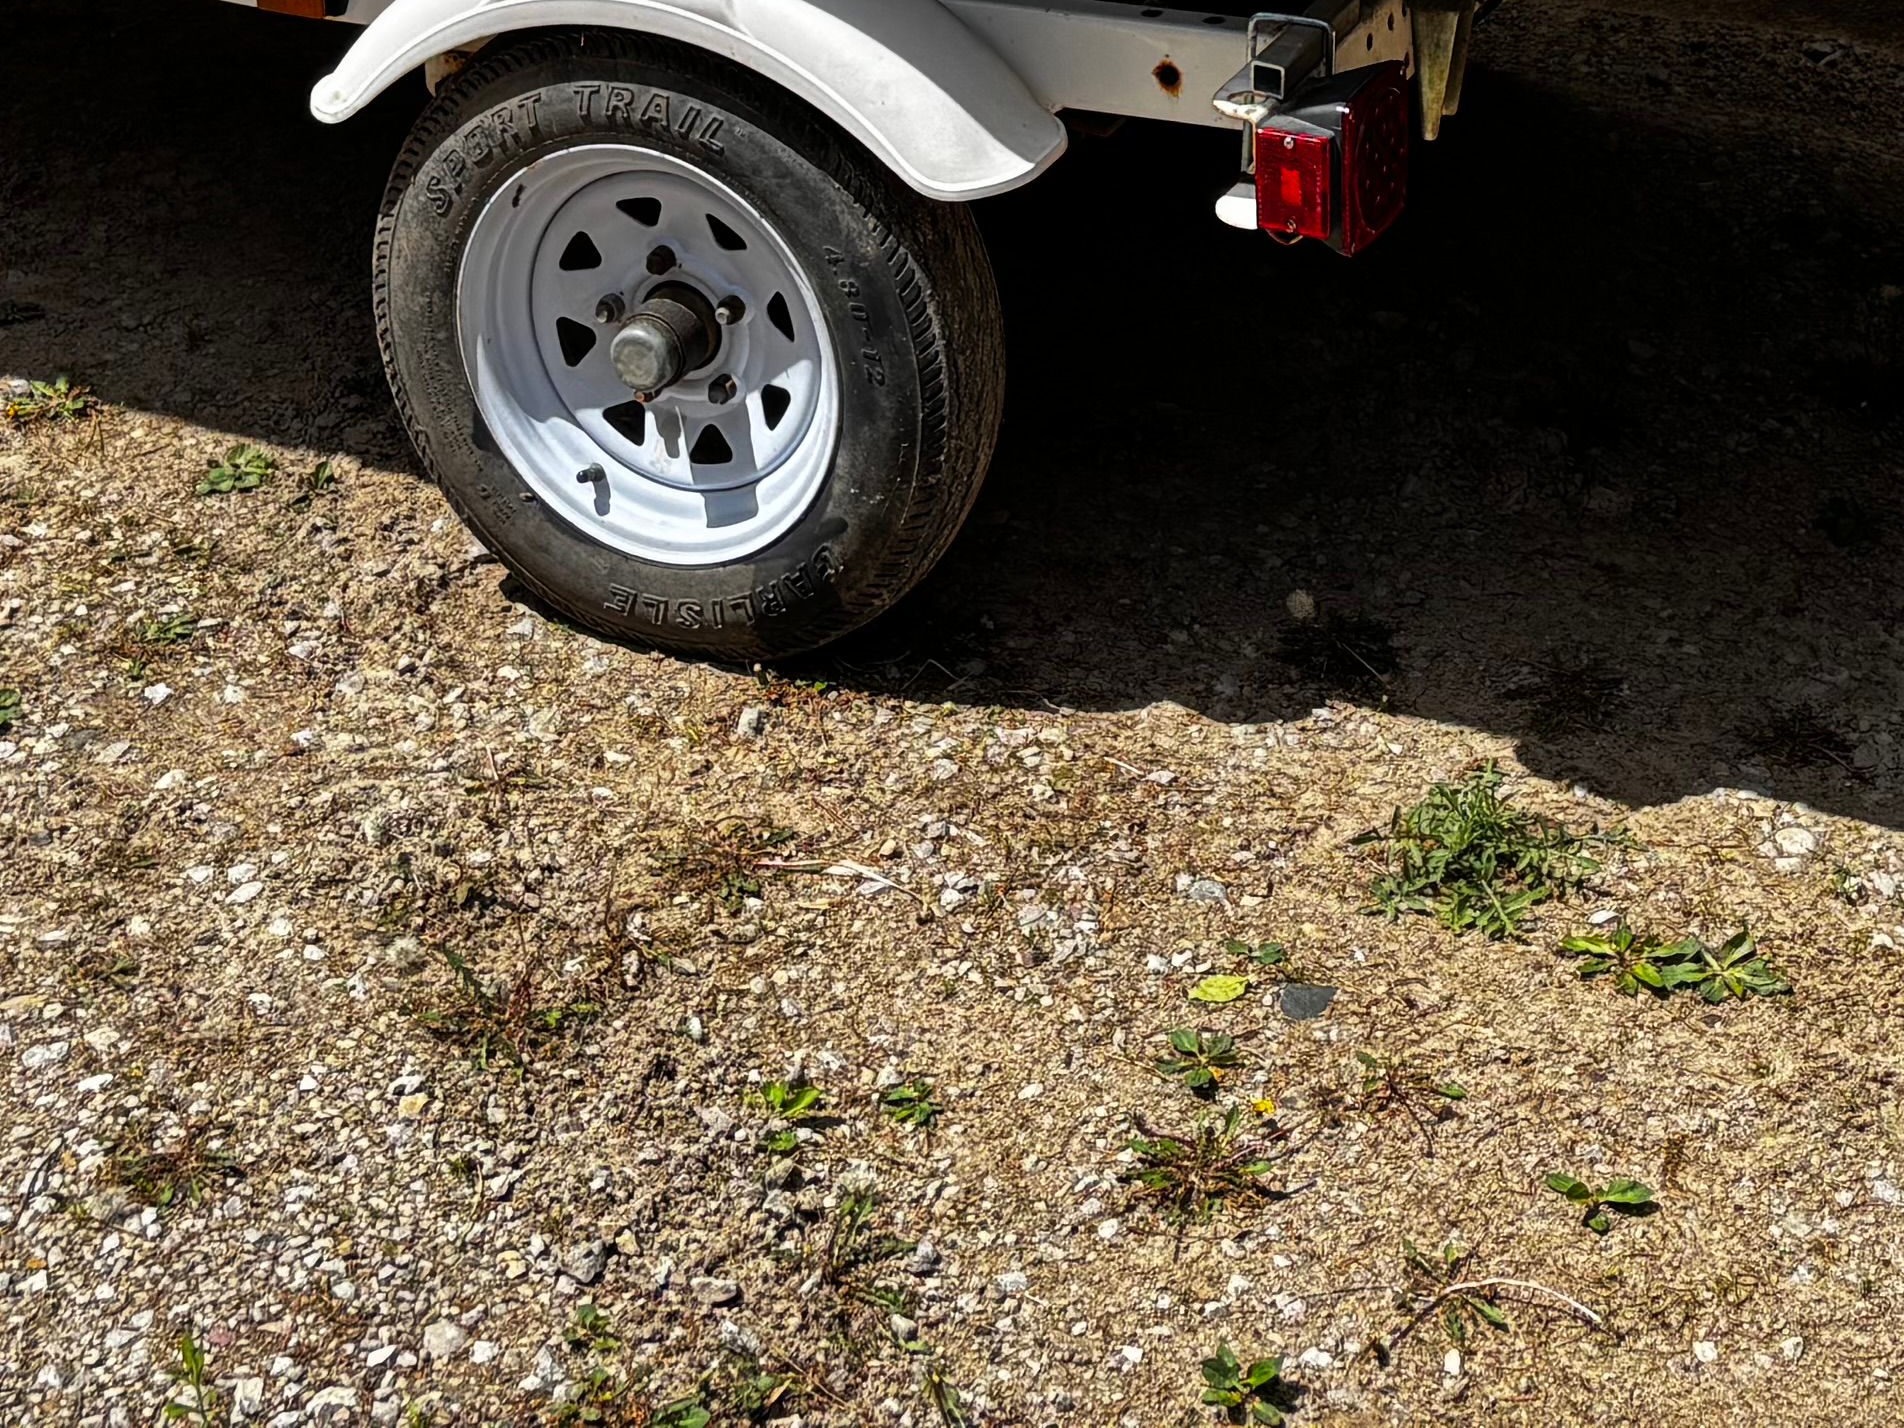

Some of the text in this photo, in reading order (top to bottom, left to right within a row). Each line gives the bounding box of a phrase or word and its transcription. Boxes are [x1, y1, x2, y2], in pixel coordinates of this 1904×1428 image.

[425, 82, 726, 216] SPORT TRAIL
[603, 541, 844, 630] CARLISLE
